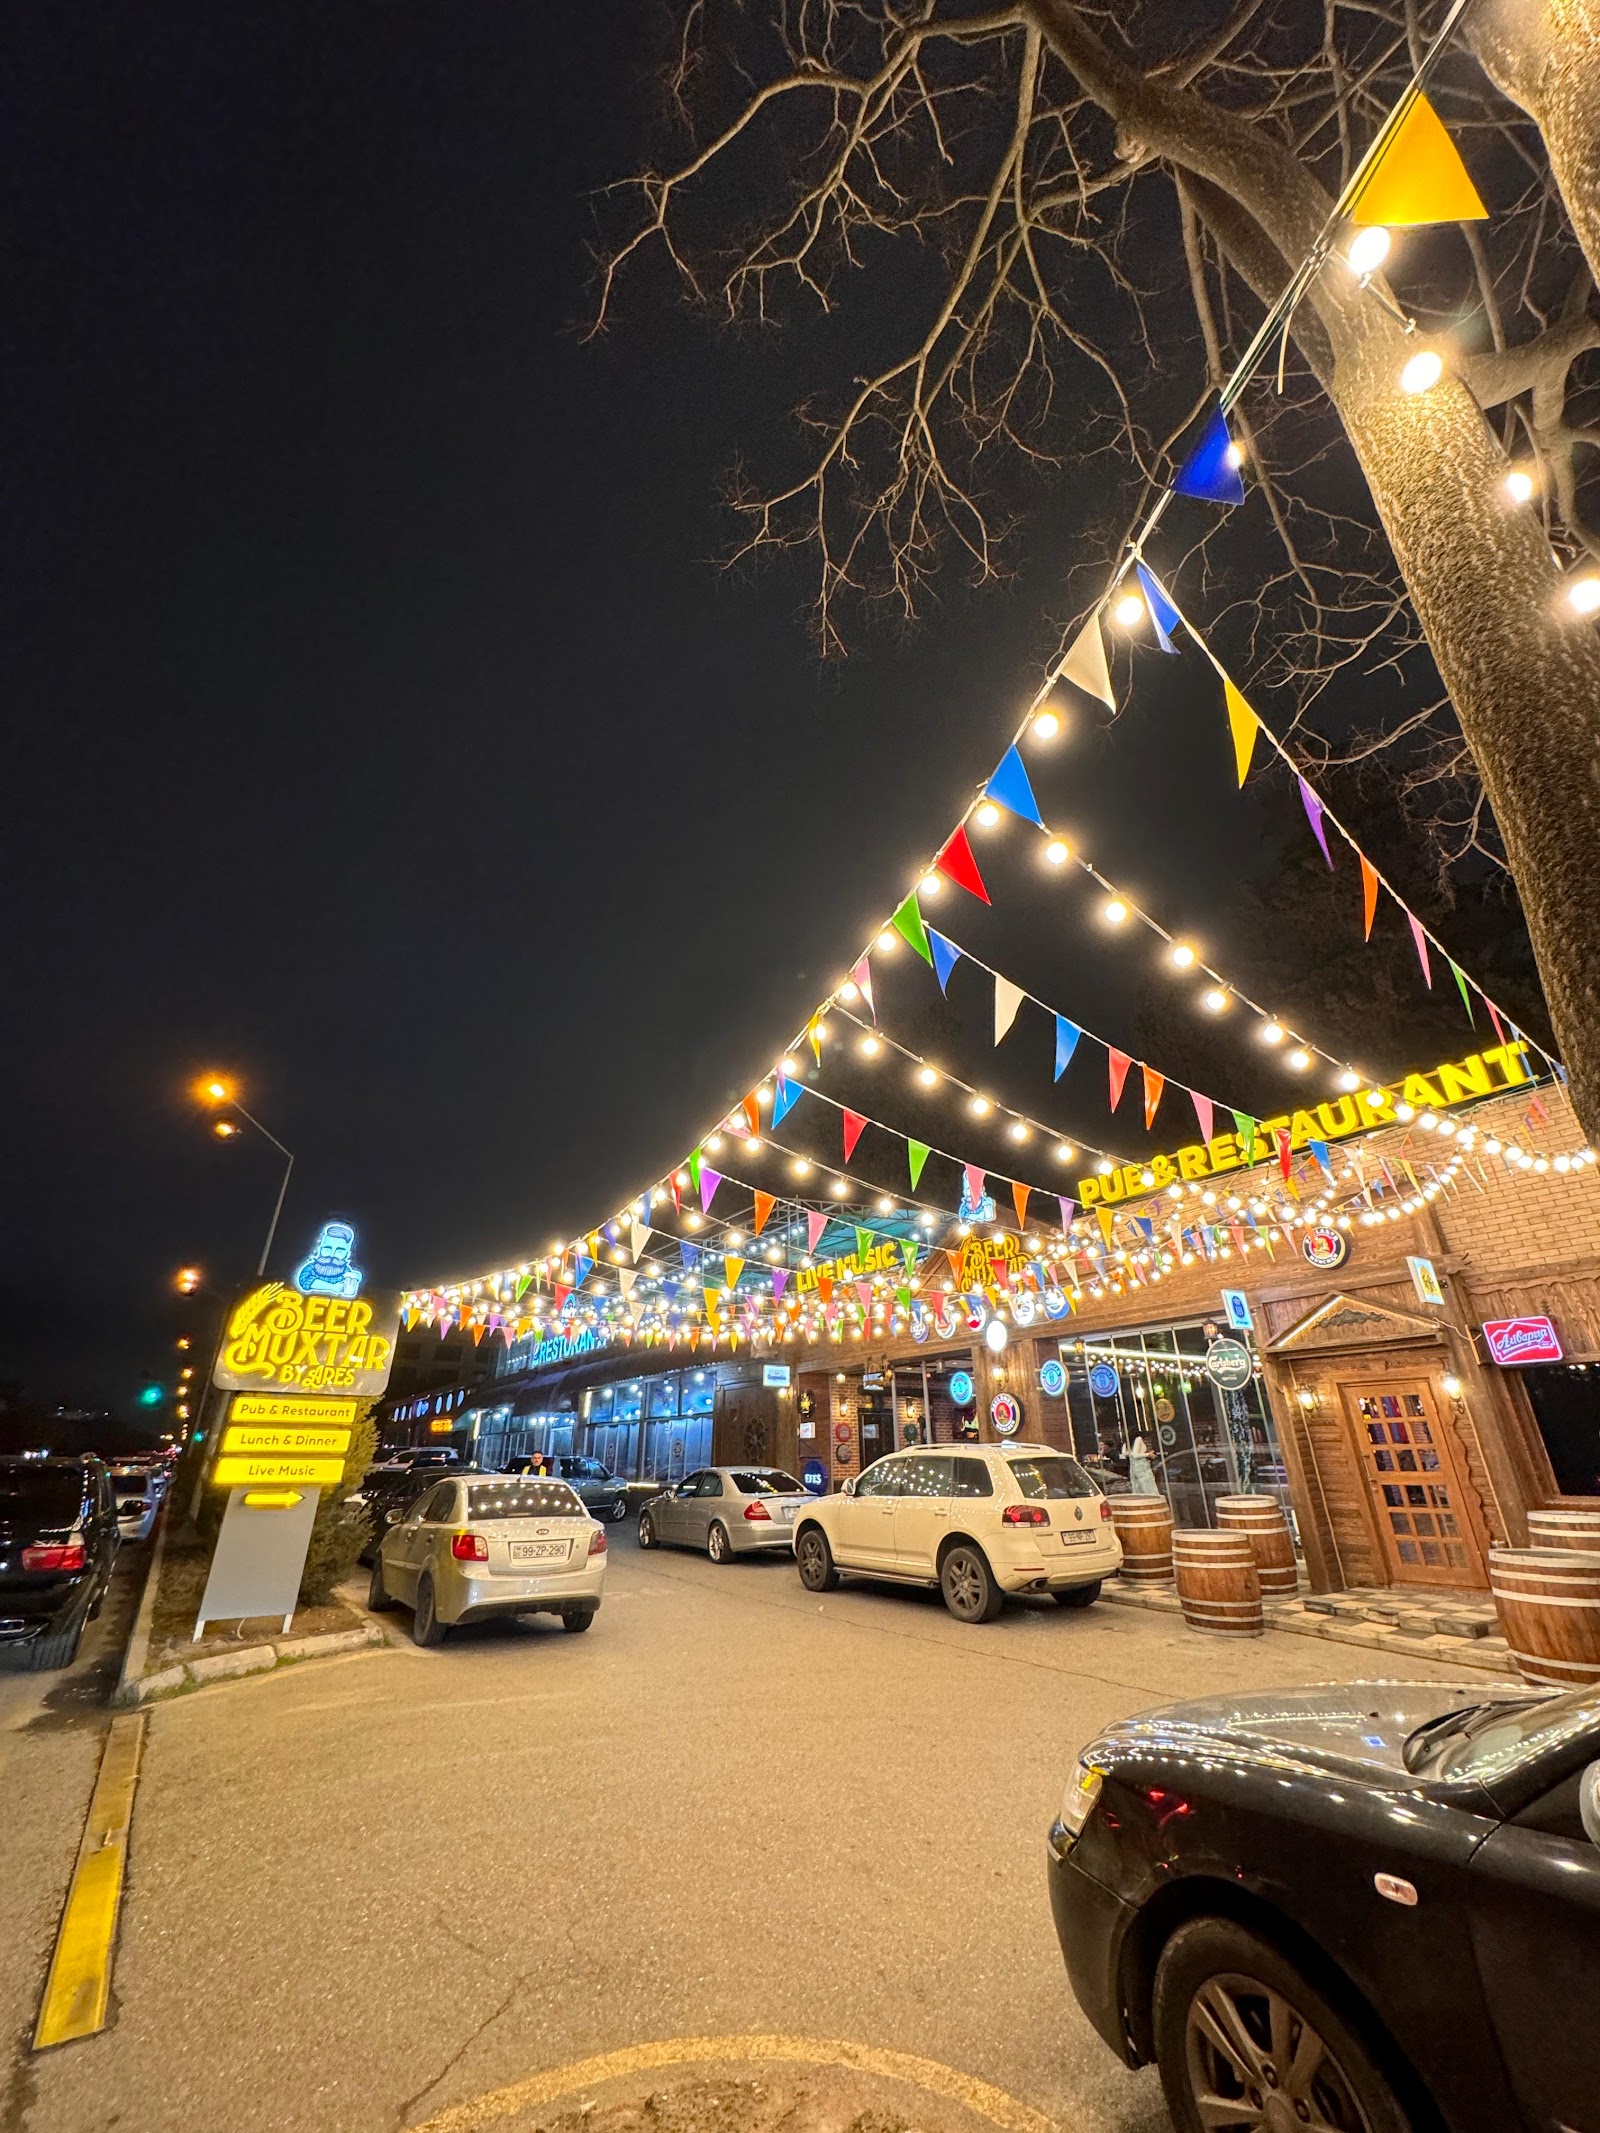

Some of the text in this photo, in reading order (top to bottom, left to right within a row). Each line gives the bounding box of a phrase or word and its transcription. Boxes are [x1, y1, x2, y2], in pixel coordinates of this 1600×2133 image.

[796, 1261, 834, 1293] LIVE
[266, 1290, 373, 1335] BEER
[225, 1324, 391, 1379] MUXTAR
[1208, 1354, 1247, 1372] Carlsberg
[279, 1365, 355, 1388] BY ARES
[240, 1404, 350, 1417] Pub & Restaurant
[240, 1434, 337, 1446] Lunch & Dinner
[248, 1465, 315, 1476] Live Music
[804, 1473, 822, 1485] EFES
[522, 1545, 565, 1557] 99-ZP-290
